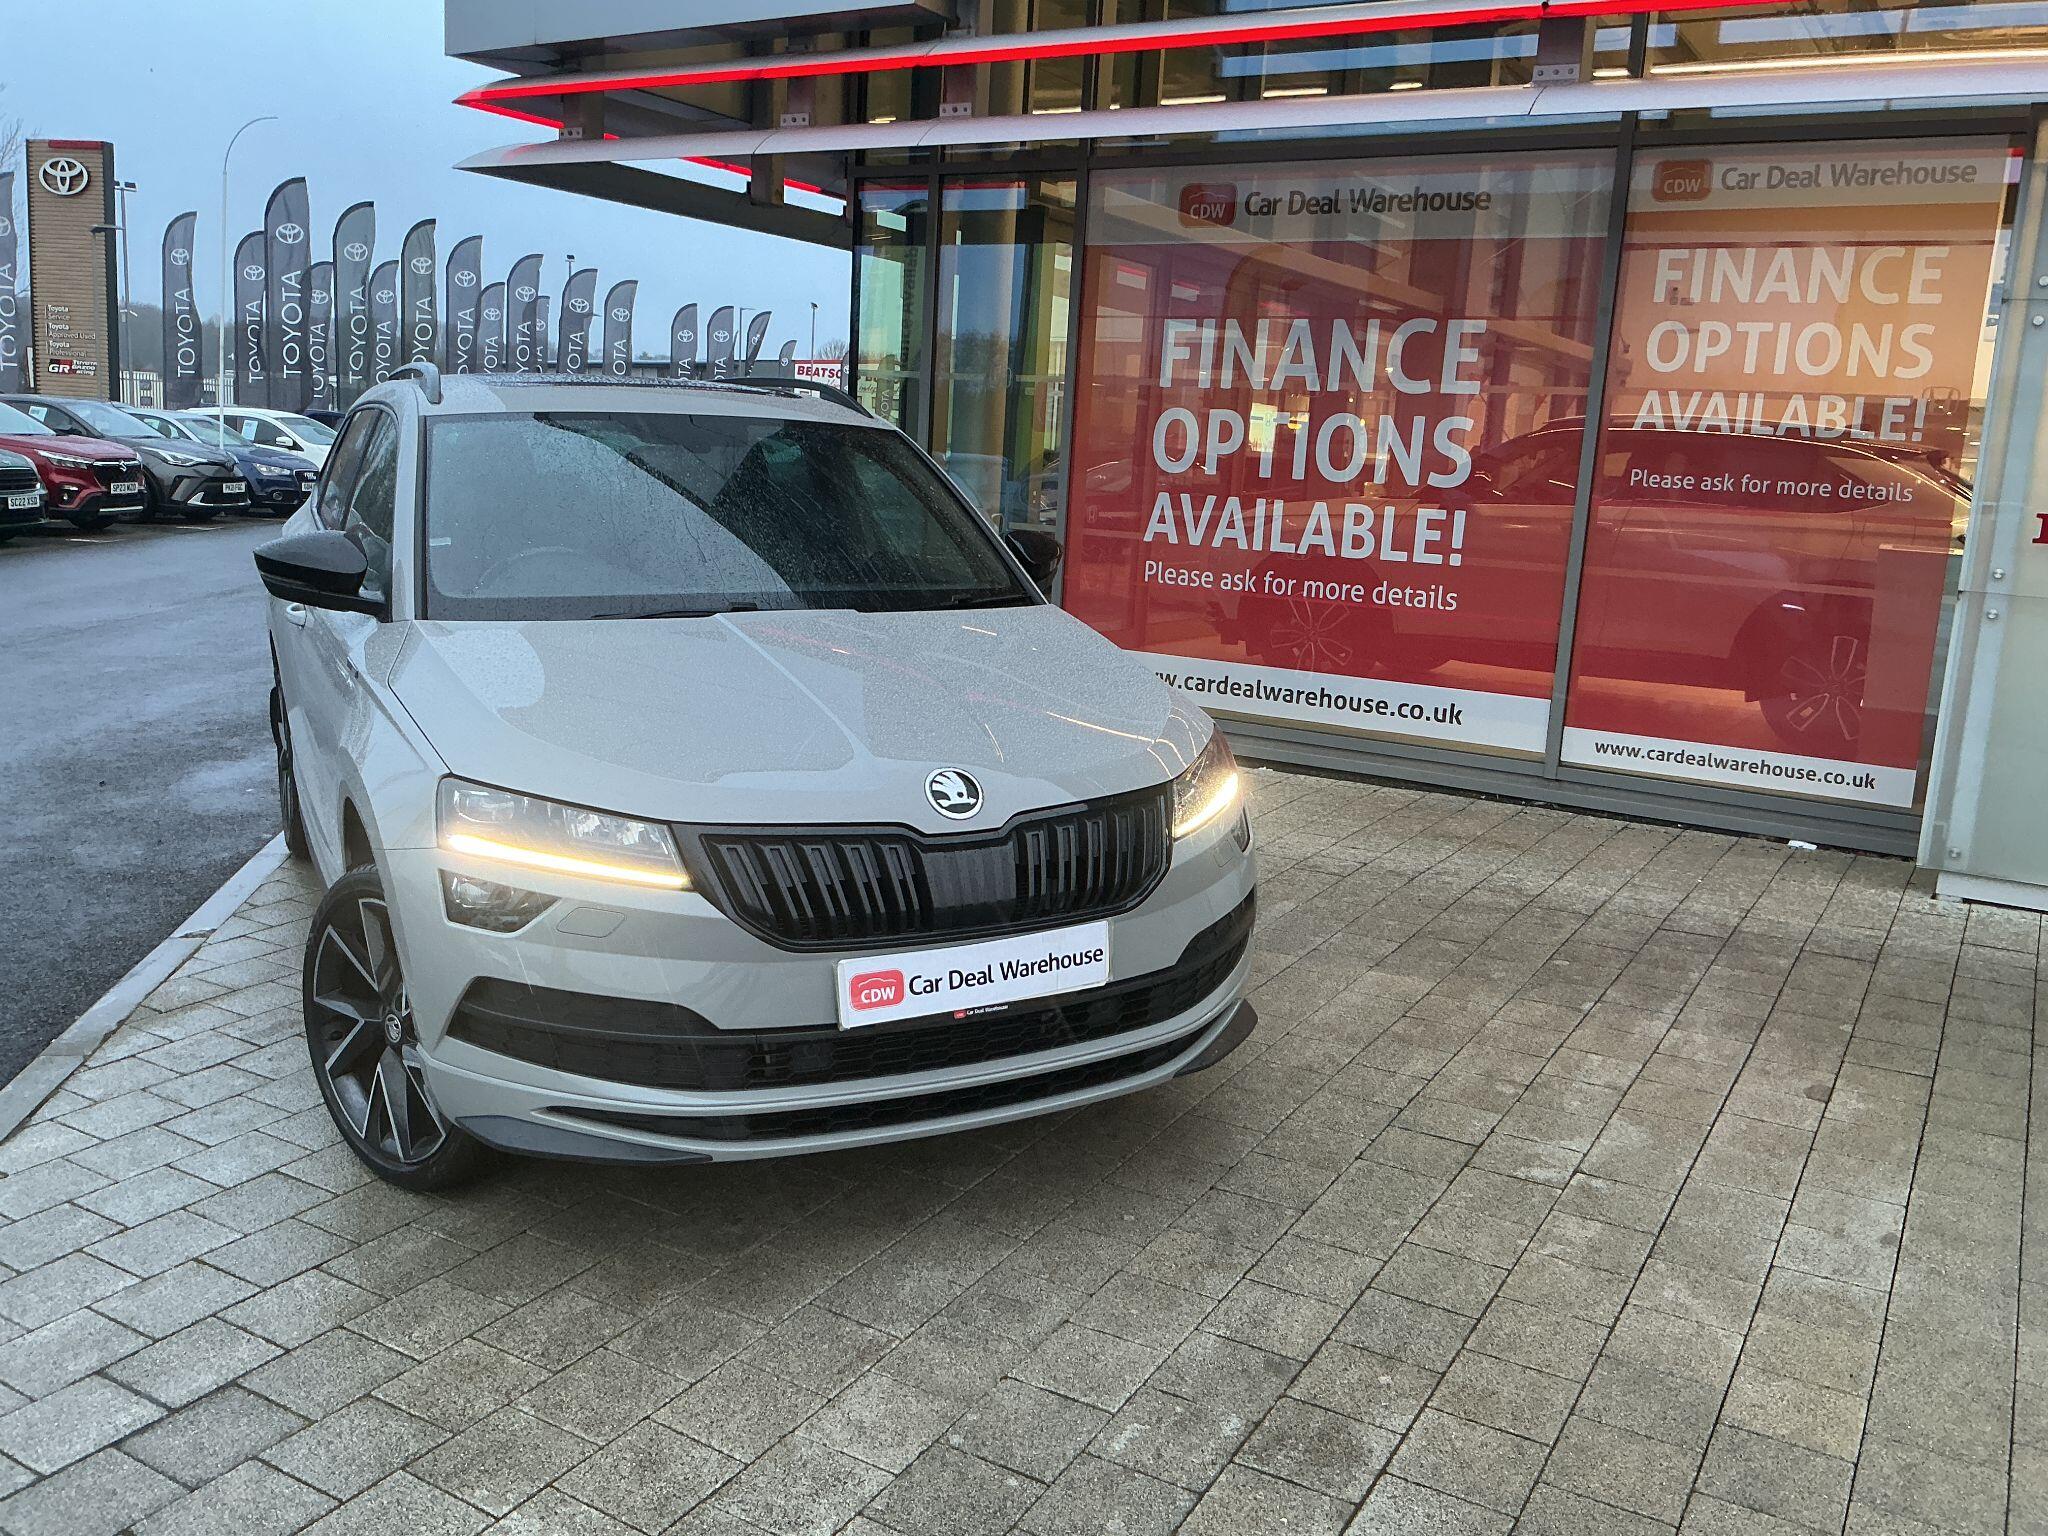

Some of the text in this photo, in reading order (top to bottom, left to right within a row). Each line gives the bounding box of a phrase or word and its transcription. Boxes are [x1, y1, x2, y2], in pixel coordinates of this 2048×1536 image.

[1189, 186, 1492, 221] CDW Car Deal Warehouse
[1663, 160, 1978, 195] CDW Car Deal Warehouse
[1652, 246, 1950, 305] FINANCE
[0, 263, 18, 373] TOYOTA
[48, 304, 69, 313] Toyota
[49, 322, 70, 331] Toyota
[79, 332, 96, 340] Used
[174, 287, 196, 378] TOYOTA
[281, 270, 302, 379] TOYOTA
[349, 285, 368, 385] TOYOTA
[411, 296, 433, 362] YOTA
[48, 363, 70, 373] GR
[50, 340, 70, 349] Toyota
[245, 300, 264, 384] TOYOTA
[376, 320, 392, 384] OYOTA
[457, 308, 475, 375] OYOTA
[516, 321, 531, 374] YOTA
[612, 339, 627, 376] OTA
[1159, 318, 1487, 395] FINANCE
[1646, 320, 1936, 379] OPTIONS
[1632, 389, 1928, 442] AVAILABLE!
[1152, 407, 1474, 489] OPTIONS
[10, 497, 26, 507] SC22
[1629, 468, 1914, 502] Please ask for more details
[1142, 491, 1467, 567] AVAILABLE!
[1144, 560, 1458, 611] Please ask for more details
[1155, 670, 1462, 725] w.cardealwarehouse.co.uk
[1594, 740, 1876, 790] www.cardealwarehouse.co.uk
[860, 947, 1104, 1003] CDW Car Deal Warehouse
